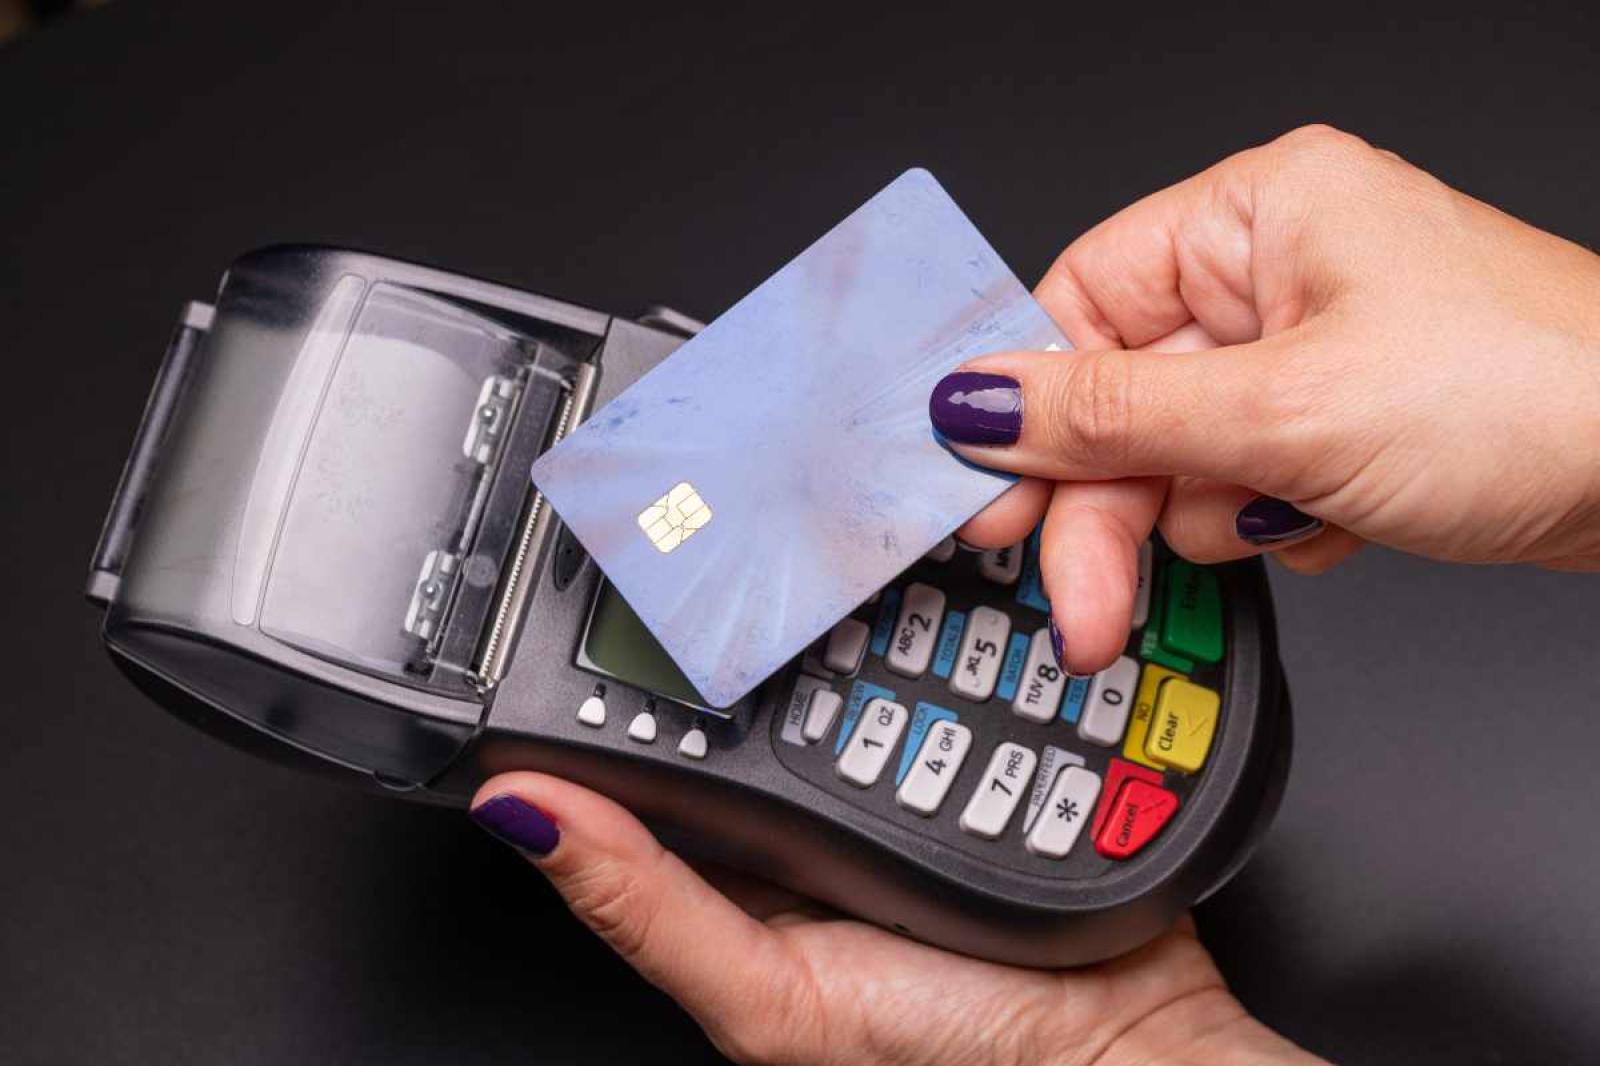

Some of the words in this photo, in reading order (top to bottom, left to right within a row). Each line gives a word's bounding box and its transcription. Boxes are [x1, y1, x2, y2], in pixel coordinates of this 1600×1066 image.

[896, 627, 916, 657] ABC
[908, 612, 933, 633] 2
[965, 655, 982, 678] JKL
[975, 637, 998, 658] 5
[1024, 681, 1046, 706] TUV
[1036, 663, 1060, 684] 8
[1101, 686, 1124, 706] 0
[862, 737, 884, 750] 1
[877, 705, 896, 727] QZ
[1135, 701, 1151, 722] NO
[1157, 711, 1181, 753] Clear
[924, 758, 948, 777] 4
[938, 726, 957, 752] GHI
[990, 777, 1013, 798] 7
[1004, 750, 1026, 780] PRS
[1115, 803, 1140, 848] Cancel
